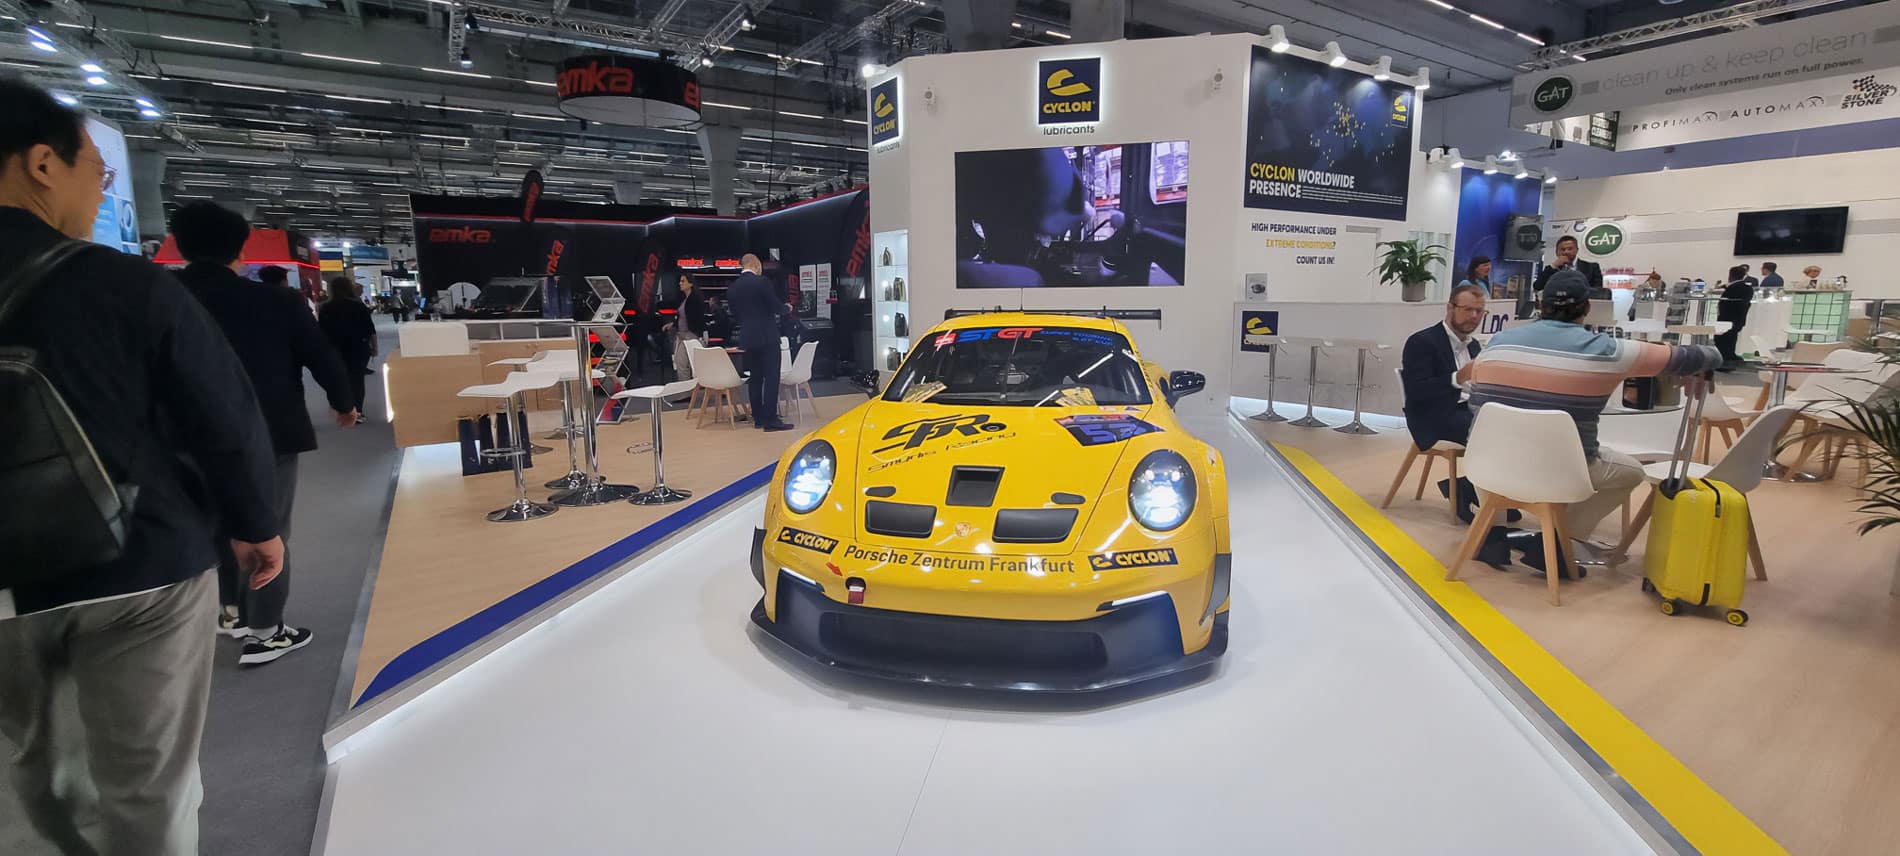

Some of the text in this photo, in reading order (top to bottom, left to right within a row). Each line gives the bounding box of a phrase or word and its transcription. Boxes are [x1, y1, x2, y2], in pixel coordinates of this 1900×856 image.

[1602, 31, 1867, 91] clean up & keep clean
[557, 61, 634, 96] emka
[1665, 85, 1687, 96] Only
[1690, 81, 1716, 91] clean
[1719, 74, 1760, 87] systems
[1762, 71, 1781, 79] run
[1784, 68, 1799, 76] on
[1802, 63, 1820, 73] full
[1537, 85, 1569, 103] GAT
[1843, 90, 1890, 103] SILVER
[1043, 100, 1092, 114] CYCLON
[1841, 97, 1885, 110] STONE
[1632, 113, 1715, 132] PROFIMAX
[1731, 99, 1820, 118] AUTOMAX
[1043, 125, 1095, 136] lubricants
[1250, 162, 1355, 189] CYCLON WORLDWIDE
[1249, 179, 1302, 199] PRESENCE
[429, 225, 491, 243] emka
[1251, 222, 1337, 235] HIGH PERFORMANCE UNDER
[1266, 239, 1295, 249] EXTREME
[1588, 232, 1620, 247] GAT
[1296, 255, 1335, 265] COUNT US IN!
[794, 533, 833, 551] CYCLON
[844, 545, 1075, 573] Porsche Zentrum Frankfurt
[1116, 551, 1171, 566] CYCLON
